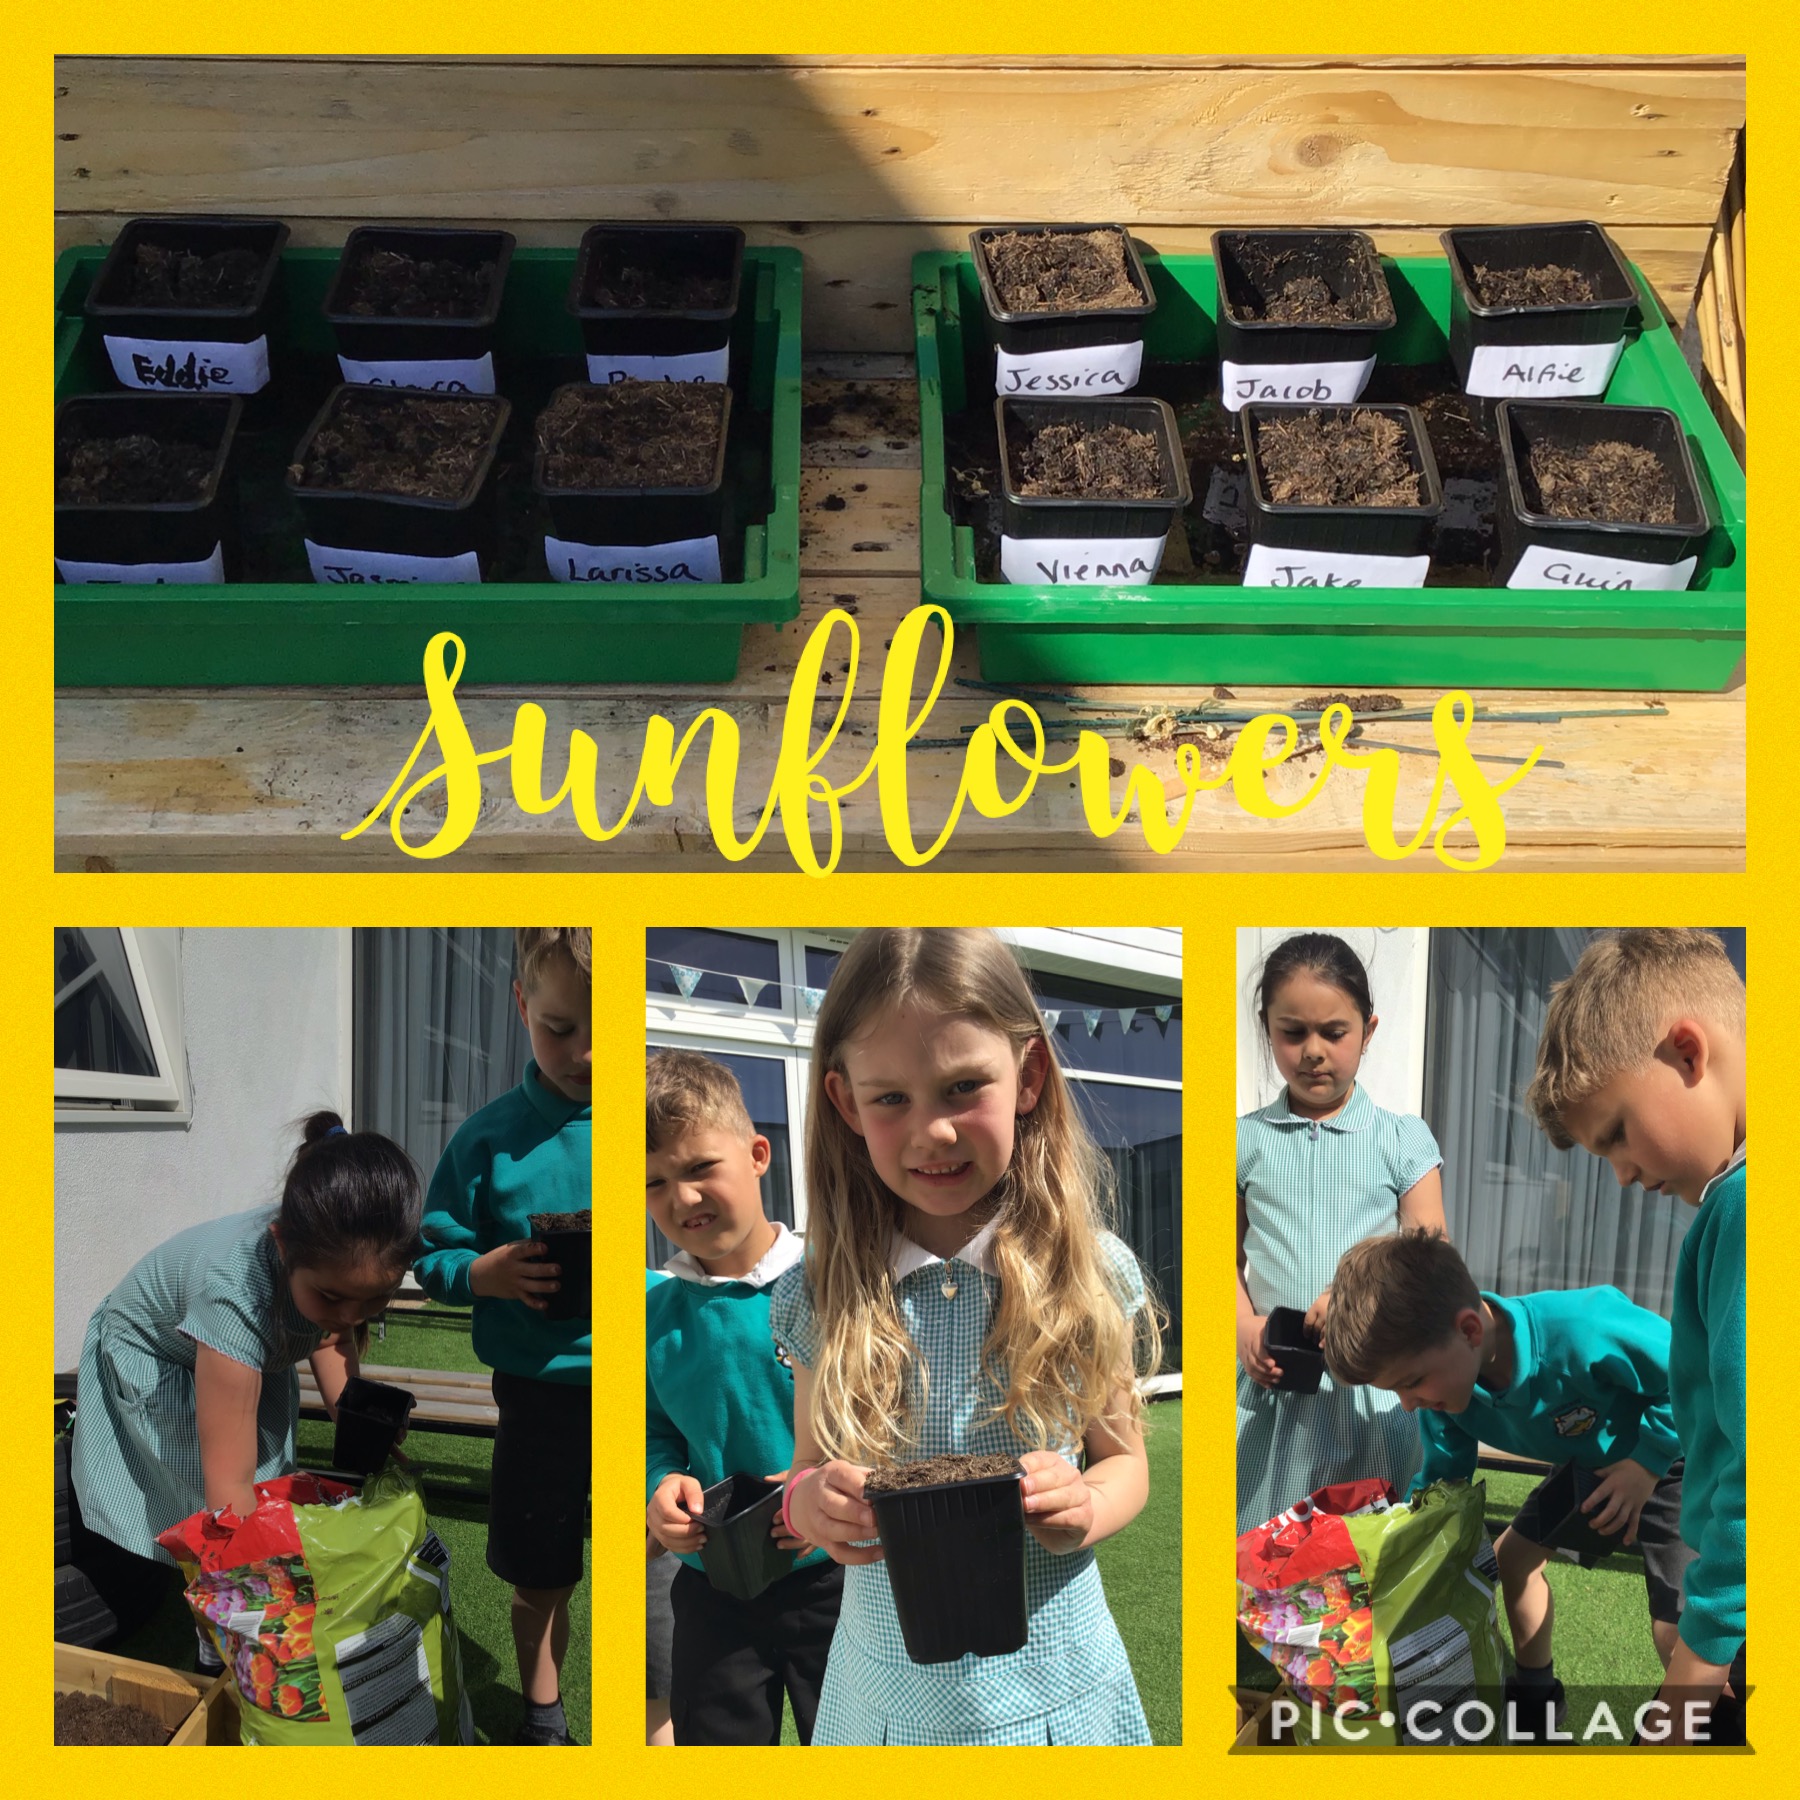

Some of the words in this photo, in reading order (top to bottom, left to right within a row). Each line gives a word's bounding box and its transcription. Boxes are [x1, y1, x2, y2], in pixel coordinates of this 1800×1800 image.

[132, 352, 233, 390] Eddie
[1004, 367, 1126, 393] Jessica
[1502, 362, 1585, 384] Alfie
[1236, 378, 1332, 401] Jacob
[568, 558, 703, 582] Larissa
[1036, 551, 1154, 584] Vienna
